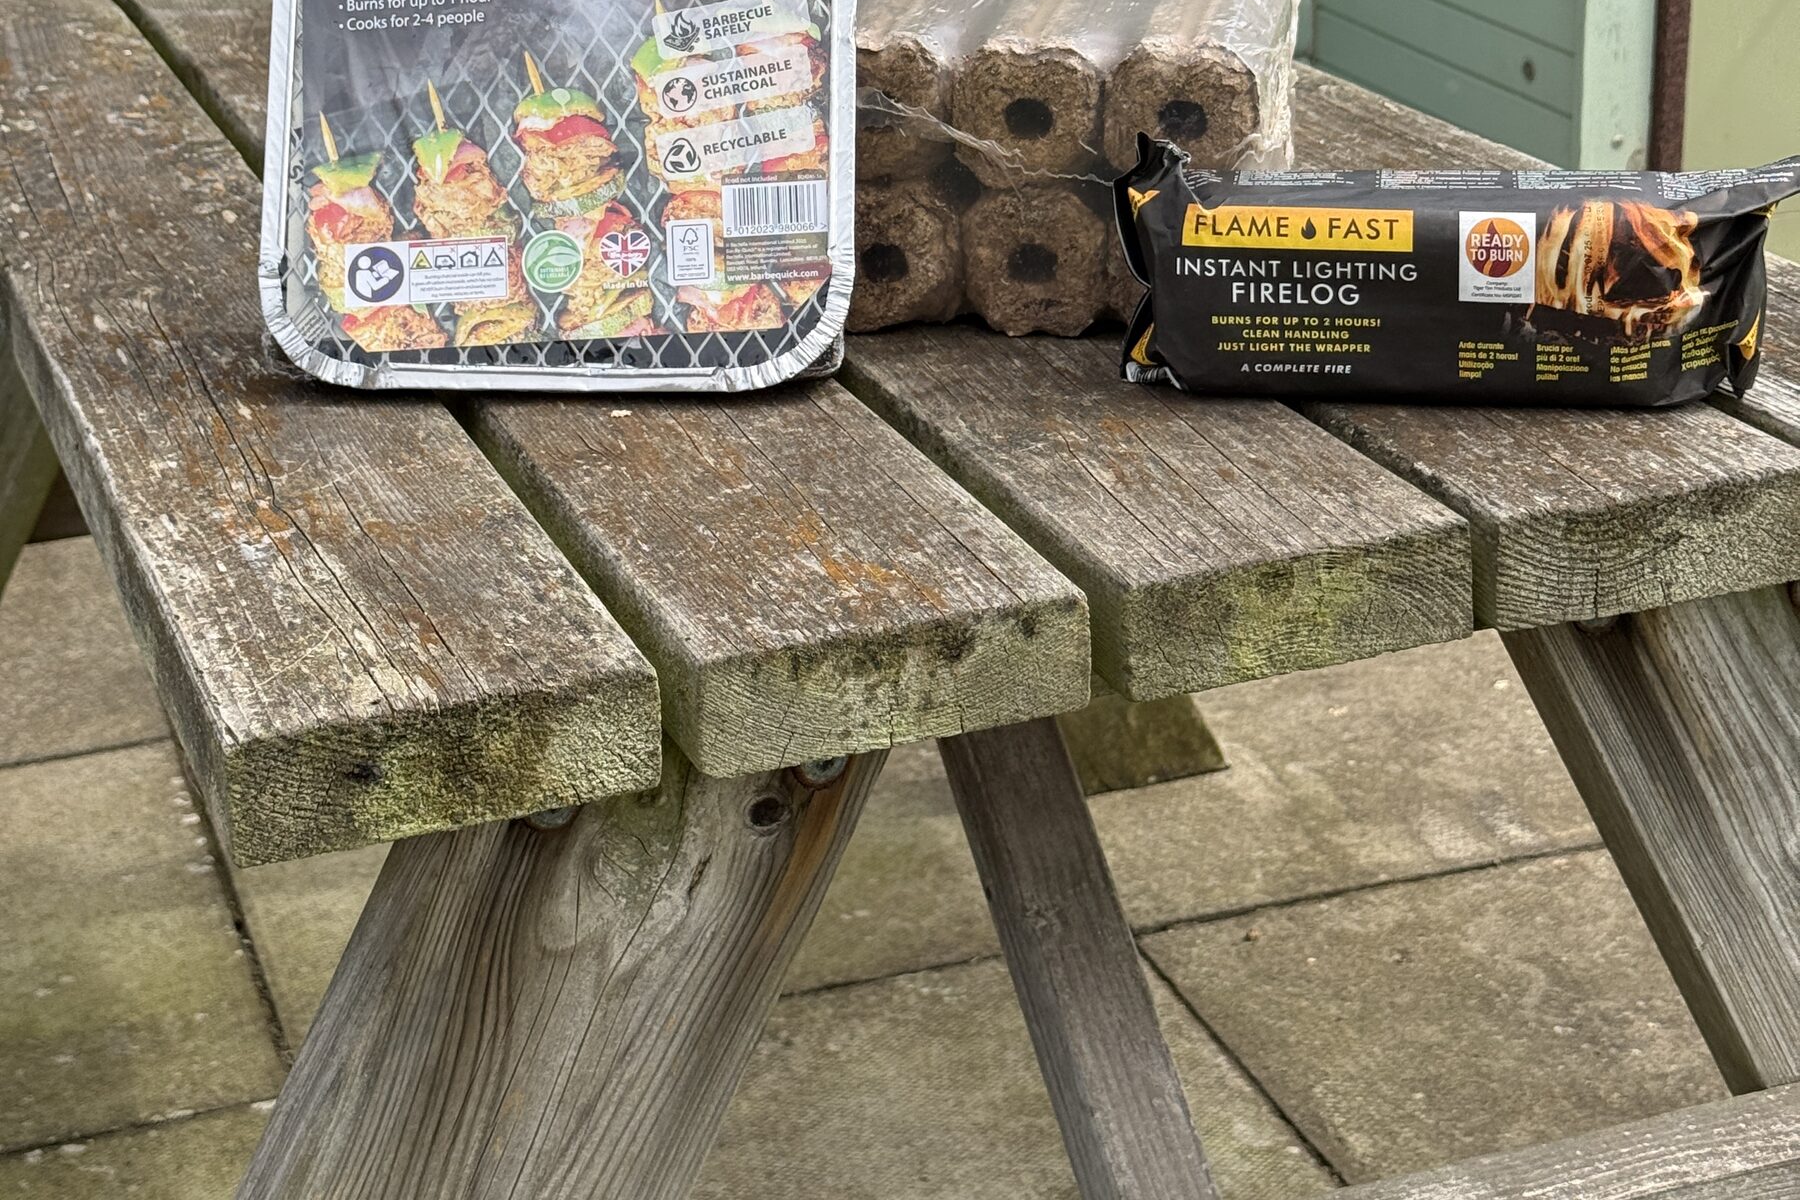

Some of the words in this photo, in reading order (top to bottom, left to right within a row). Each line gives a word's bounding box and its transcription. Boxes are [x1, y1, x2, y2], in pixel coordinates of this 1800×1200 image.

[346, 14, 388, 32] Cooks
[390, 13, 409, 28] for
[412, 13, 434, 27] 2-4
[437, 8, 485, 28] people
[702, 5, 773, 29] BARBECUE
[704, 21, 751, 41] SAFELY
[701, 59, 793, 88] SUSTAINABLE
[704, 76, 777, 101] CHARCOAL
[702, 128, 787, 156] RECYCLABLE
[751, 174, 778, 182] included
[726, 226, 733, 236] 5
[738, 223, 775, 235] 012023
[778, 221, 815, 233] 980066
[1194, 214, 1290, 238] FLAME
[1328, 217, 1399, 241] FAST
[1471, 233, 1524, 248] READY
[1470, 249, 1486, 261] TO
[1490, 249, 1523, 262] BURN
[727, 269, 819, 281] www.barbequick.com
[1175, 257, 1281, 278] INSTANT
[1293, 261, 1418, 281] LIGHTING
[1231, 282, 1360, 306] FIRELOG
[1211, 315, 1251, 325] BURNS
[1255, 316, 1279, 326] FOR
[1283, 316, 1299, 326] UP
[1303, 317, 1319, 326] TO
[1323, 317, 1331, 326] 2
[1335, 317, 1381, 328] HOURS!
[1242, 329, 1280, 339] CLEAN
[1284, 330, 1350, 340] HANDLING
[1217, 342, 1245, 352] JUST
[1249, 342, 1285, 352] LIGHT
[1289, 343, 1312, 352] THE
[1315, 343, 1371, 353] WRAPPER
[1458, 341, 1475, 349] Arde
[1536, 344, 1560, 352] Brucia
[1561, 345, 1573, 353] per
[1459, 351, 1476, 359] mais
[1240, 363, 1250, 373] A
[1254, 363, 1320, 373] COMPLETE
[1324, 364, 1352, 374] FIRE
[1536, 363, 1589, 373] Manipolazione
